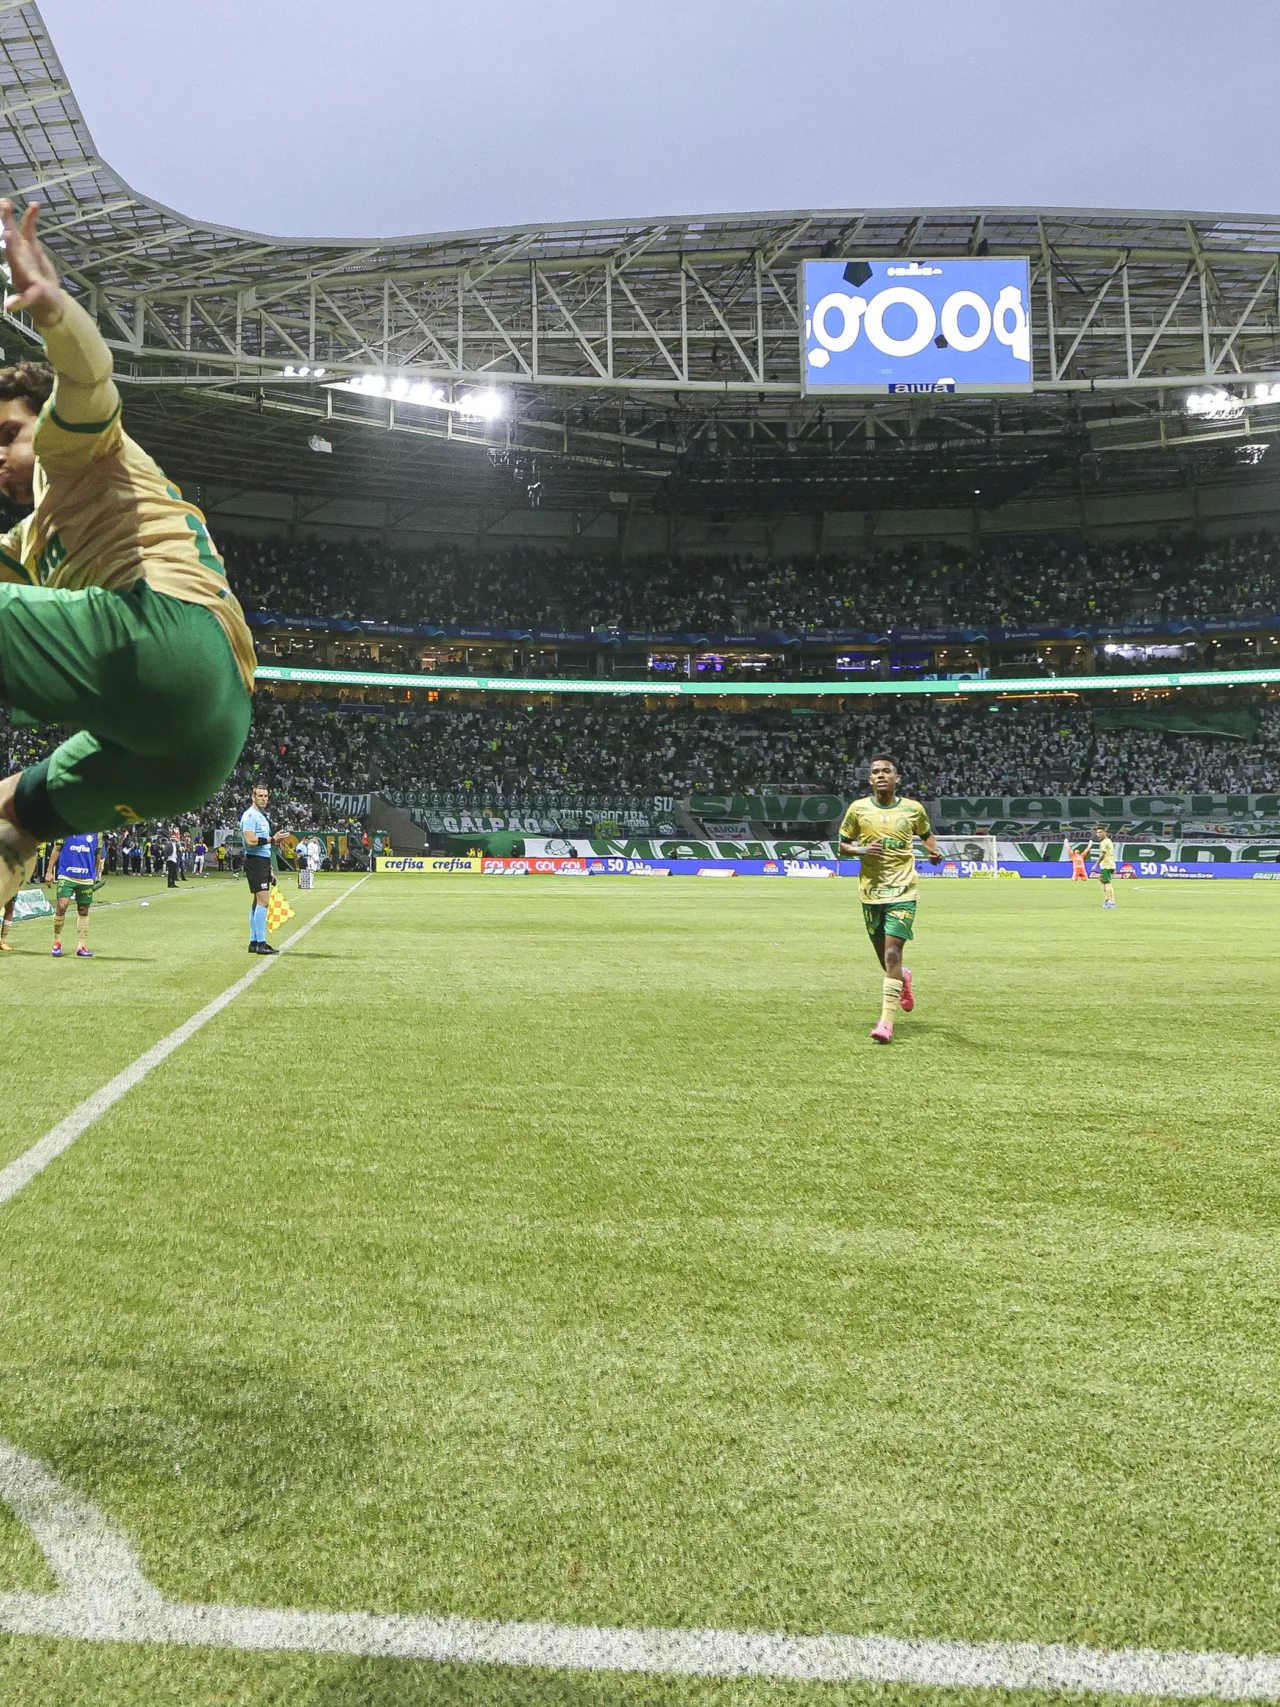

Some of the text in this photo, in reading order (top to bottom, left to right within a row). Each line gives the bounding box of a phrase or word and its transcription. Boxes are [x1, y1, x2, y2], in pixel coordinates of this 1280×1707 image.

[384, 857, 472, 871] crefisa crefisa
[535, 861, 557, 871] GOL
[607, 859, 624, 872] 50
[1140, 862, 1157, 875] 50
[971, 870, 1014, 878] quartolit
